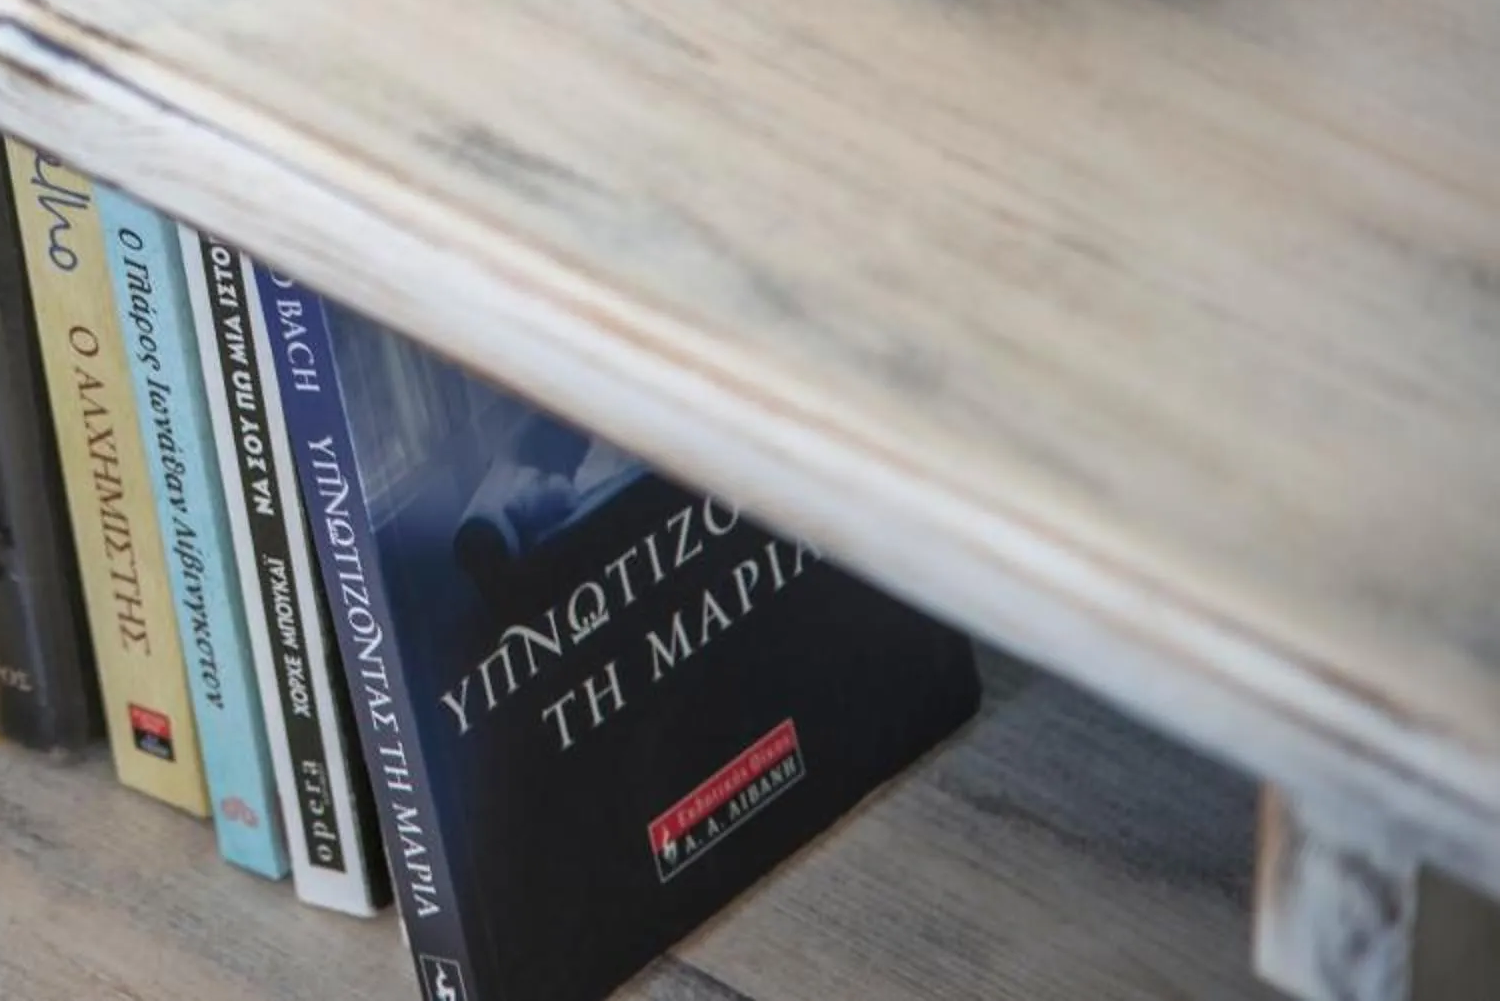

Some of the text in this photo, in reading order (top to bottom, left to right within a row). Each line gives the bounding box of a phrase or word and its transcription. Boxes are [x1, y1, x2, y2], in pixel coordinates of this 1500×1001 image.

[68, 325, 100, 358] Ο
[208, 236, 275, 516] ΝΑ ΣΟΥ ΠΩ ΜΙΑ ΙΣΤΟ
[275, 299, 321, 392] BACH
[75, 366, 151, 656] ΑΛΧΗΜΙΣΤΗΣ
[118, 227, 226, 711] Ο Γλάρος Ιωνάθαν Λίβινγκστον
[279, 653, 312, 718] ΧΟΡΧΕ
[307, 434, 442, 919] ΥΠΝΩΤΙΖΟΝΤΑΣ ΤΗ ΜΑΡΙΑ
[541, 660, 627, 751] ΤΗ
[301, 759, 338, 862] opera
